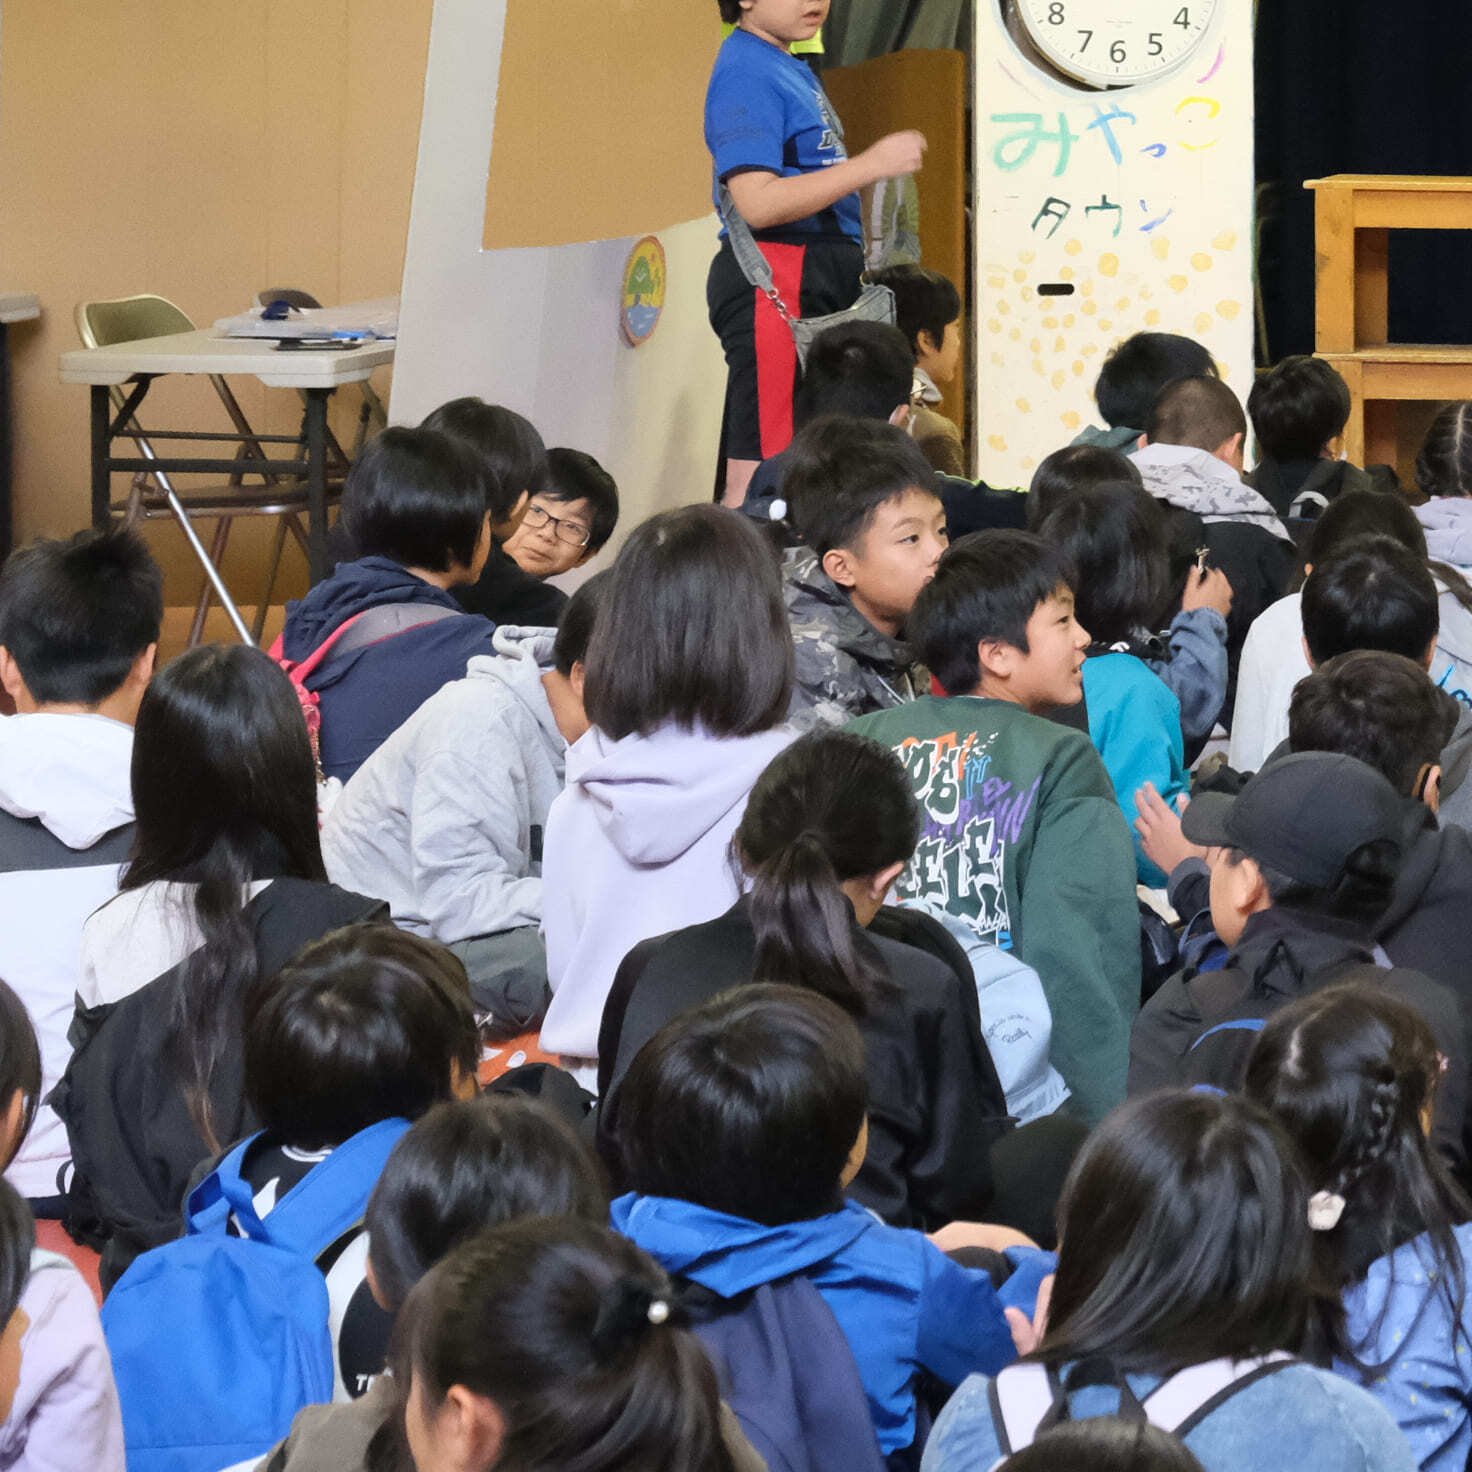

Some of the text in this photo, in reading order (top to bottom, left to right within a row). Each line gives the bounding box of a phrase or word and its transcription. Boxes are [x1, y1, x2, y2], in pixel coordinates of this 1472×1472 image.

[1047, 1, 1065, 25] 8
[1172, 6, 1191, 30] 4
[1077, 29, 1093, 53] 7
[1109, 39, 1126, 64] 6
[1147, 32, 1163, 56] 5
[989, 95, 1222, 177] みやっこ
[1030, 194, 1173, 240] タウン
